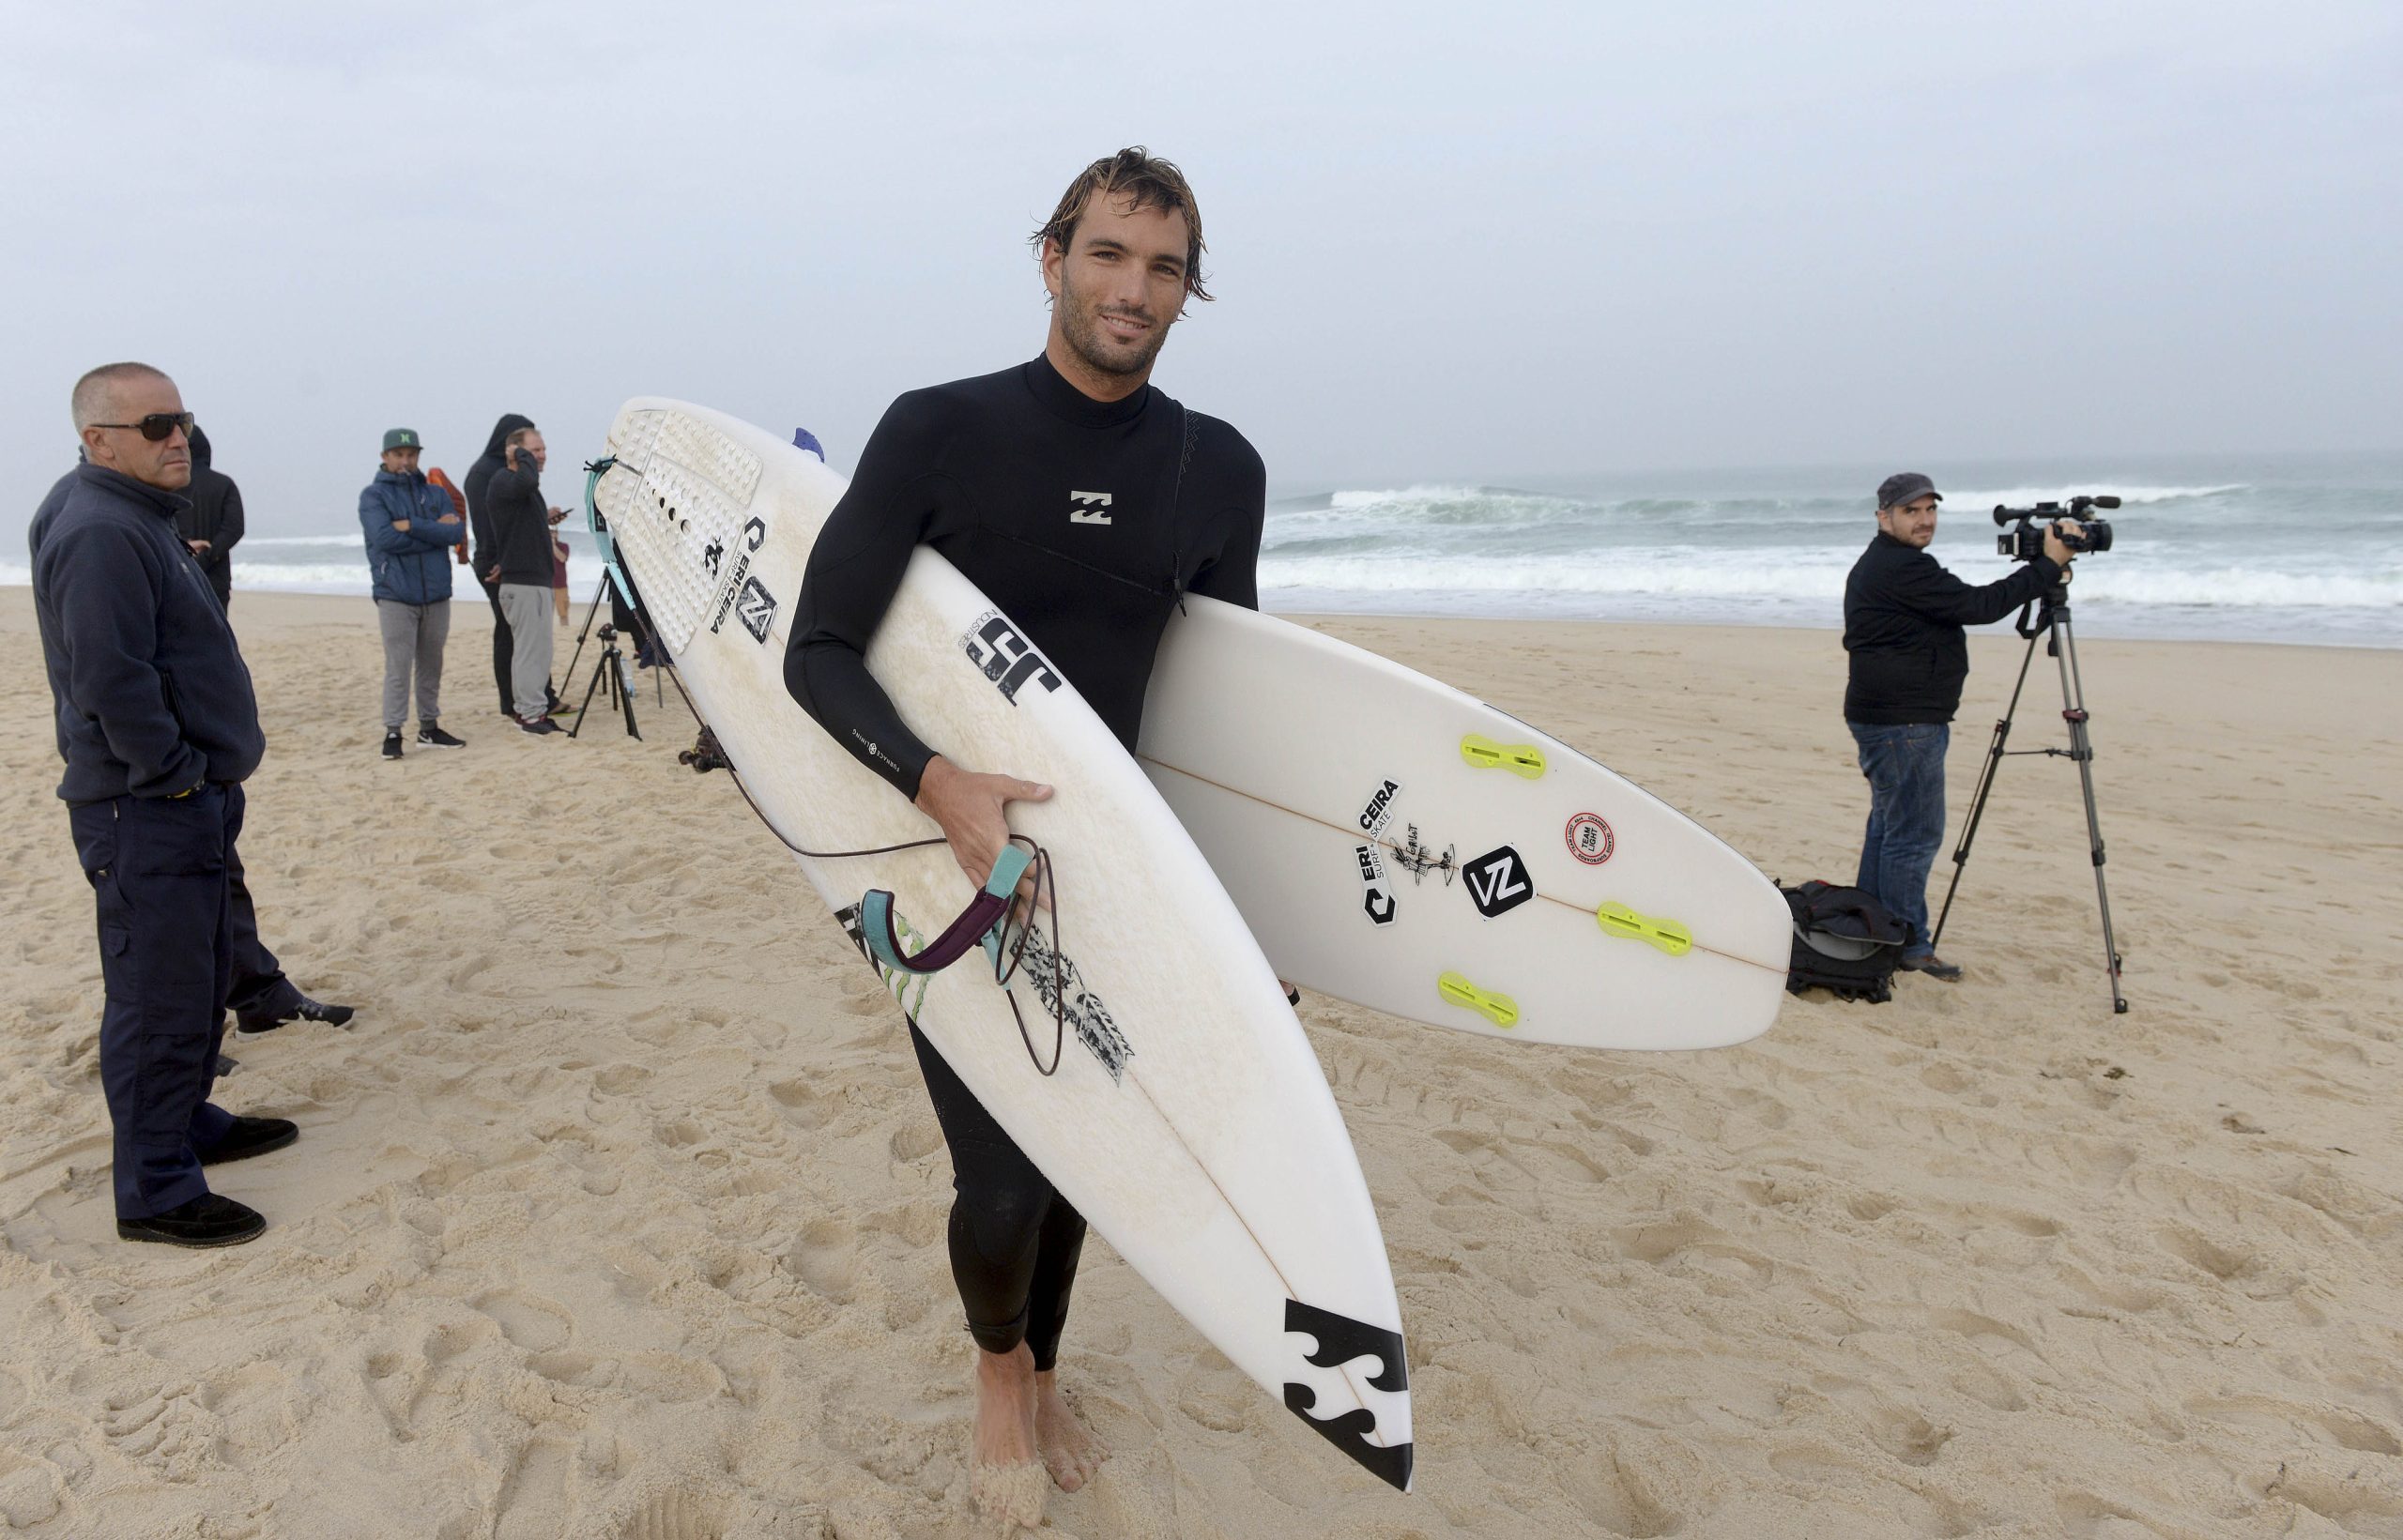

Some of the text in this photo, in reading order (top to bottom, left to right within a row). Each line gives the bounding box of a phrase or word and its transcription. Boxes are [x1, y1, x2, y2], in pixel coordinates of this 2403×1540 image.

[730, 550, 742, 575] SURF
[711, 554, 750, 634] ERI CEIRA
[851, 728, 900, 772] FURNACE LINING
[1355, 780, 1399, 881] ERI CEIRA
[1582, 826, 1591, 848] TEAM
[1588, 816, 1607, 831] CHANNEL
[1588, 827, 1598, 852] LIGHT
[1370, 810, 1391, 878] SURF SKATE
